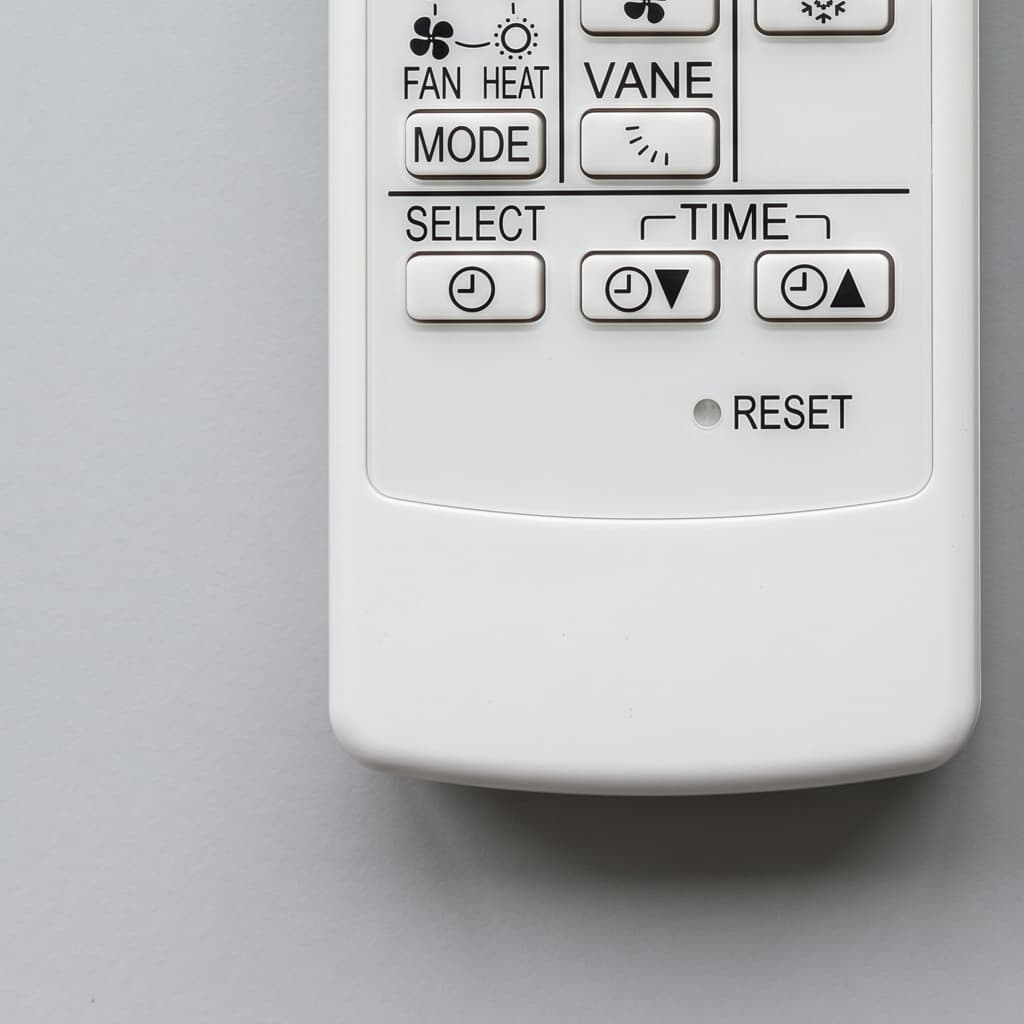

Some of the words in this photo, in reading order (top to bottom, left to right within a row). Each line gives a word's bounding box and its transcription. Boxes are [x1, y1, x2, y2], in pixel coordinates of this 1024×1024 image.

[403, 66, 461, 100] FAN
[483, 66, 549, 99] HEAT
[584, 62, 713, 99] VANE
[414, 127, 529, 163] MODE
[406, 205, 545, 242] SELECT
[681, 203, 789, 240] TIME
[733, 395, 852, 429] RESET
